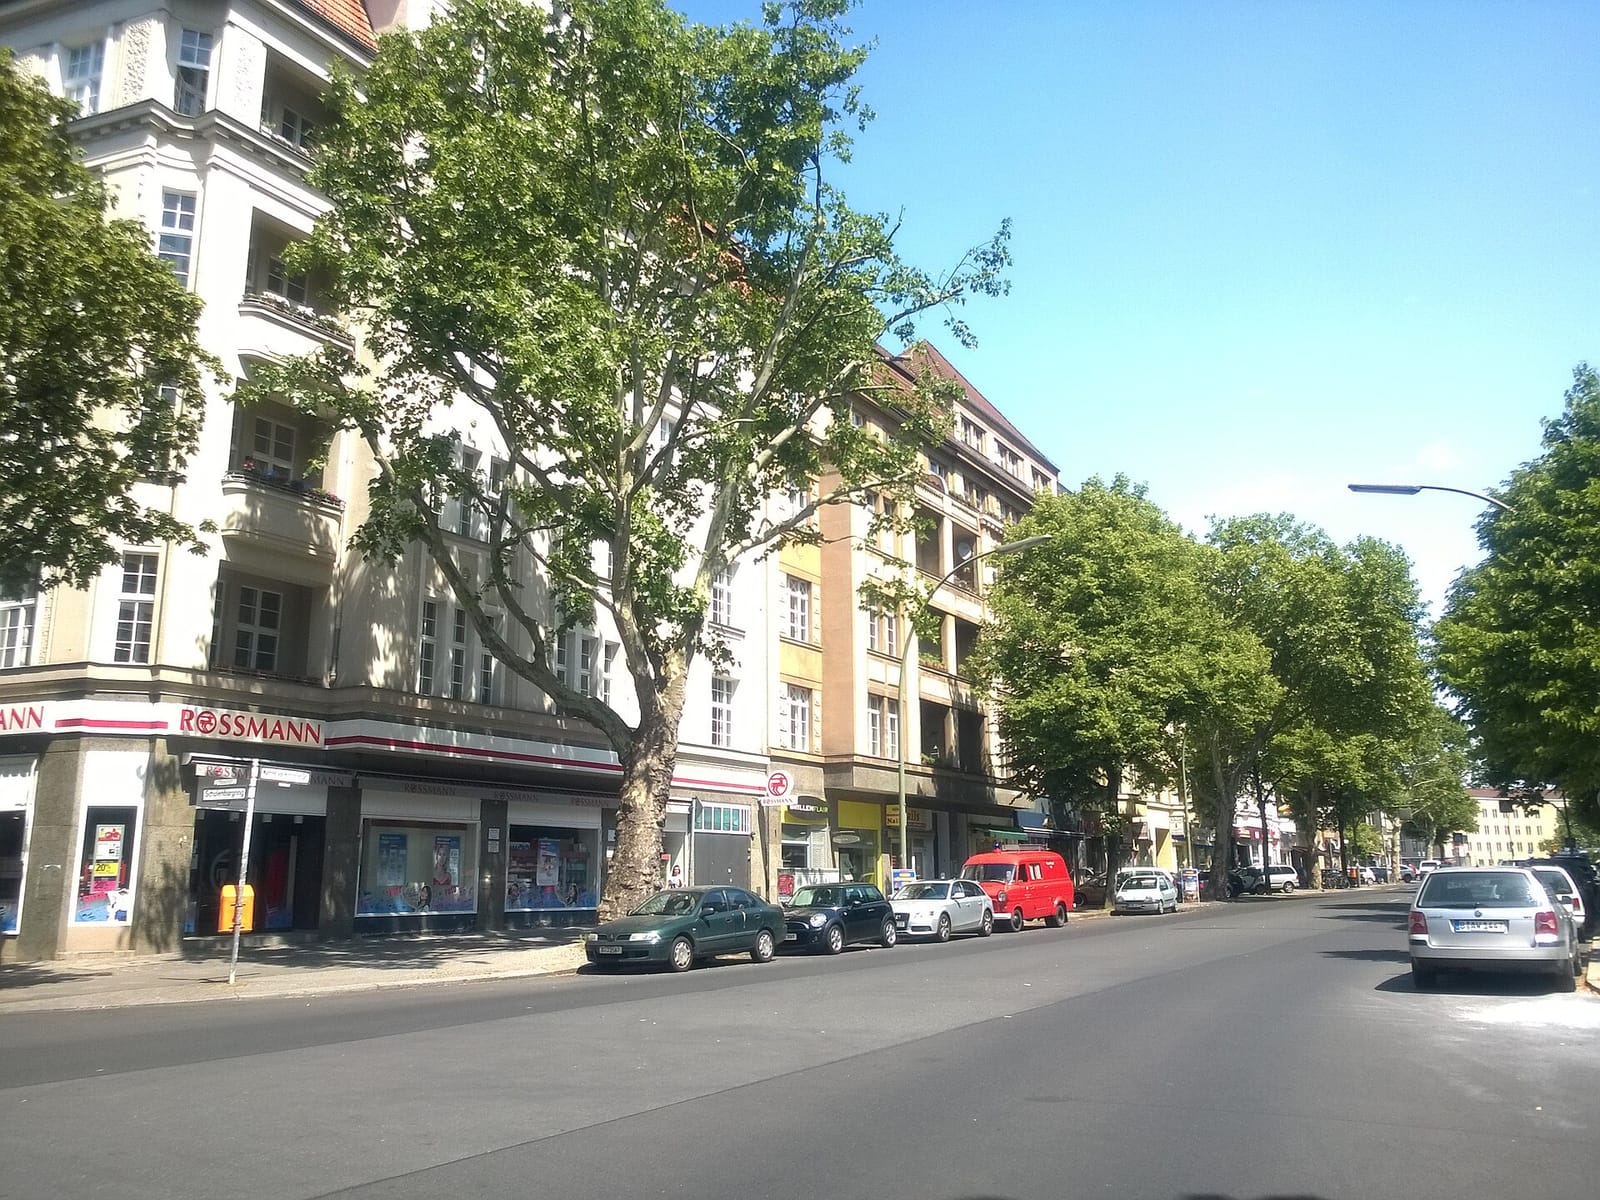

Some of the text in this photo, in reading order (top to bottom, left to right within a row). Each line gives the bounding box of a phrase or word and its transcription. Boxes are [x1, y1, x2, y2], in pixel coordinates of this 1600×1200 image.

[179, 709, 321, 744] ROSSMANN
[206, 765, 248, 779] ROSSM
[311, 775, 344, 786] MANN
